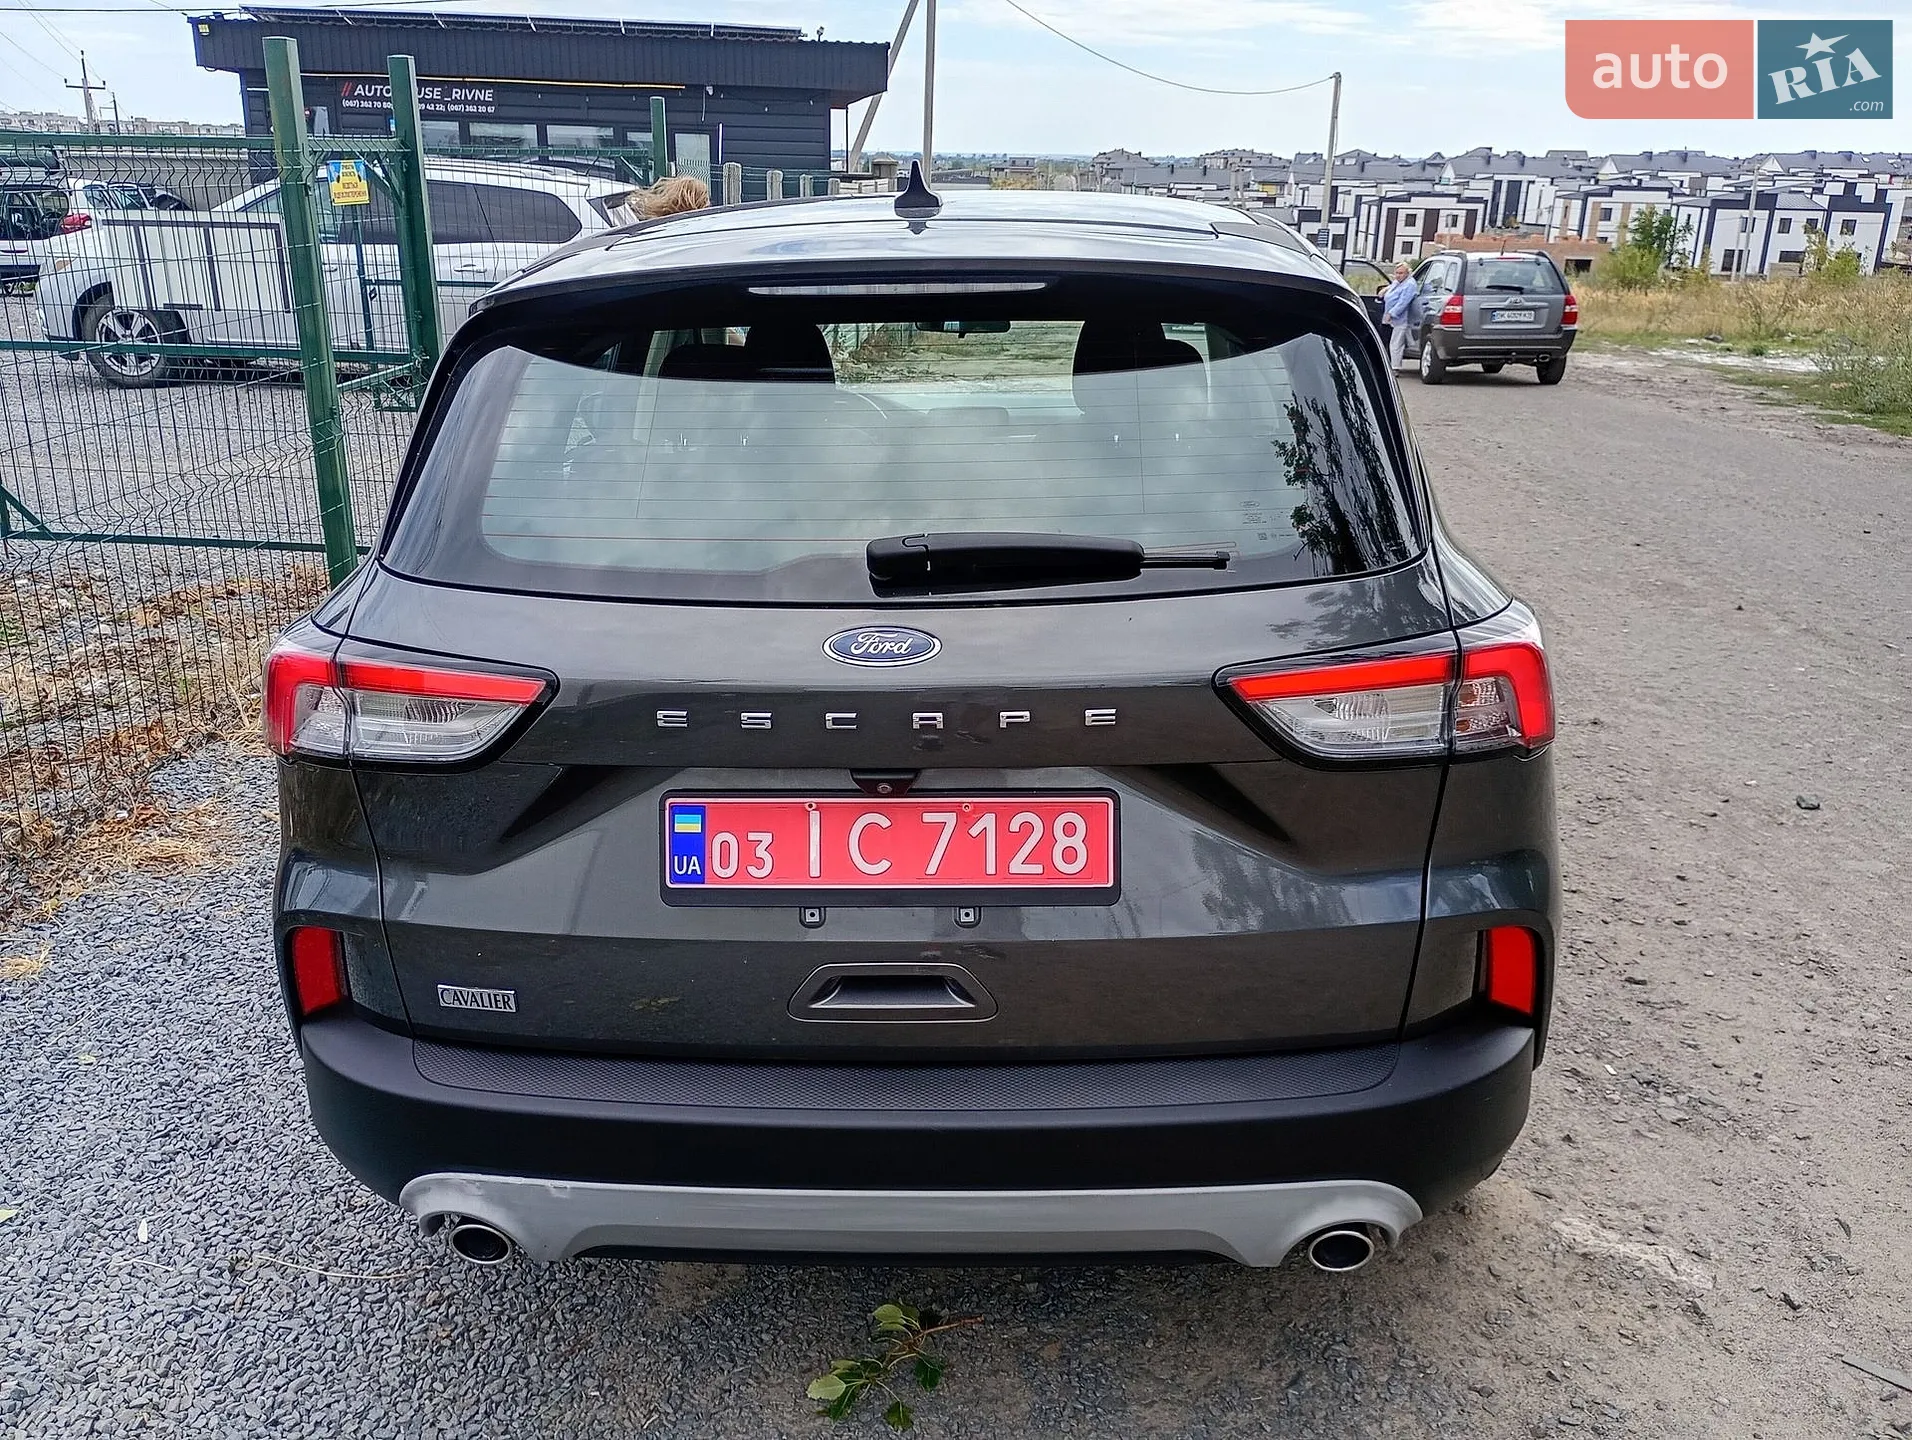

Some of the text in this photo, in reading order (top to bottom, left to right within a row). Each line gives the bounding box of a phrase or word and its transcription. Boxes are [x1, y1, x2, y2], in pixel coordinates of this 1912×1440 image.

[850, 632, 914, 655] Ford
[656, 709, 1117, 729] ESCAPE
[711, 832, 774, 879] 03
[921, 811, 1088, 877] 7128
[673, 856, 701, 875] UA
[440, 989, 513, 1010] CAVALIER
